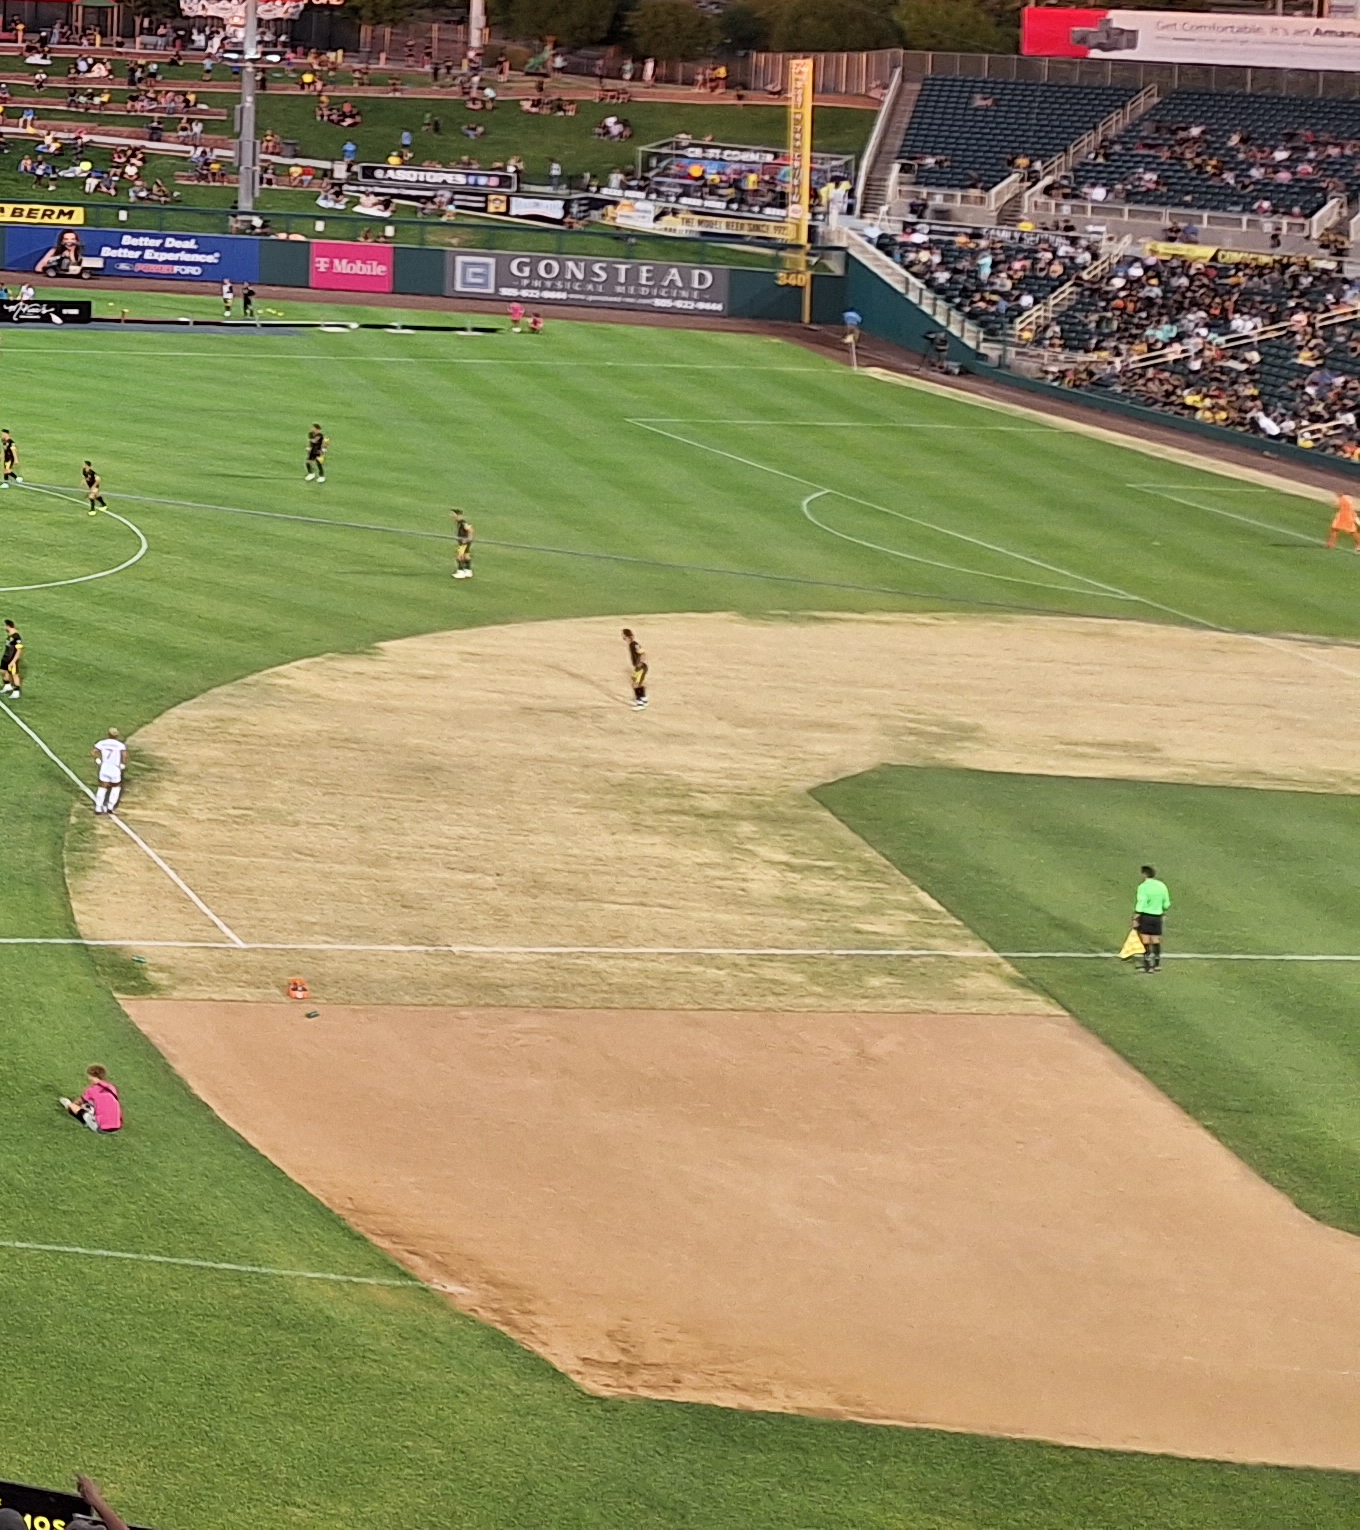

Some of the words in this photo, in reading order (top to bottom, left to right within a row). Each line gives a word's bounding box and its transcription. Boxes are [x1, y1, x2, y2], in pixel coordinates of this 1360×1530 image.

[9, 206, 76, 220] BERM
[120, 234, 164, 249] Better
[165, 236, 199, 250] Deal.
[100, 246, 142, 260] Better
[314, 256, 331, 272] T
[331, 257, 388, 276] Mobile
[509, 256, 714, 291] GONSTEAD
[776, 272, 807, 287] 340
[104, 748, 114, 761] 7
